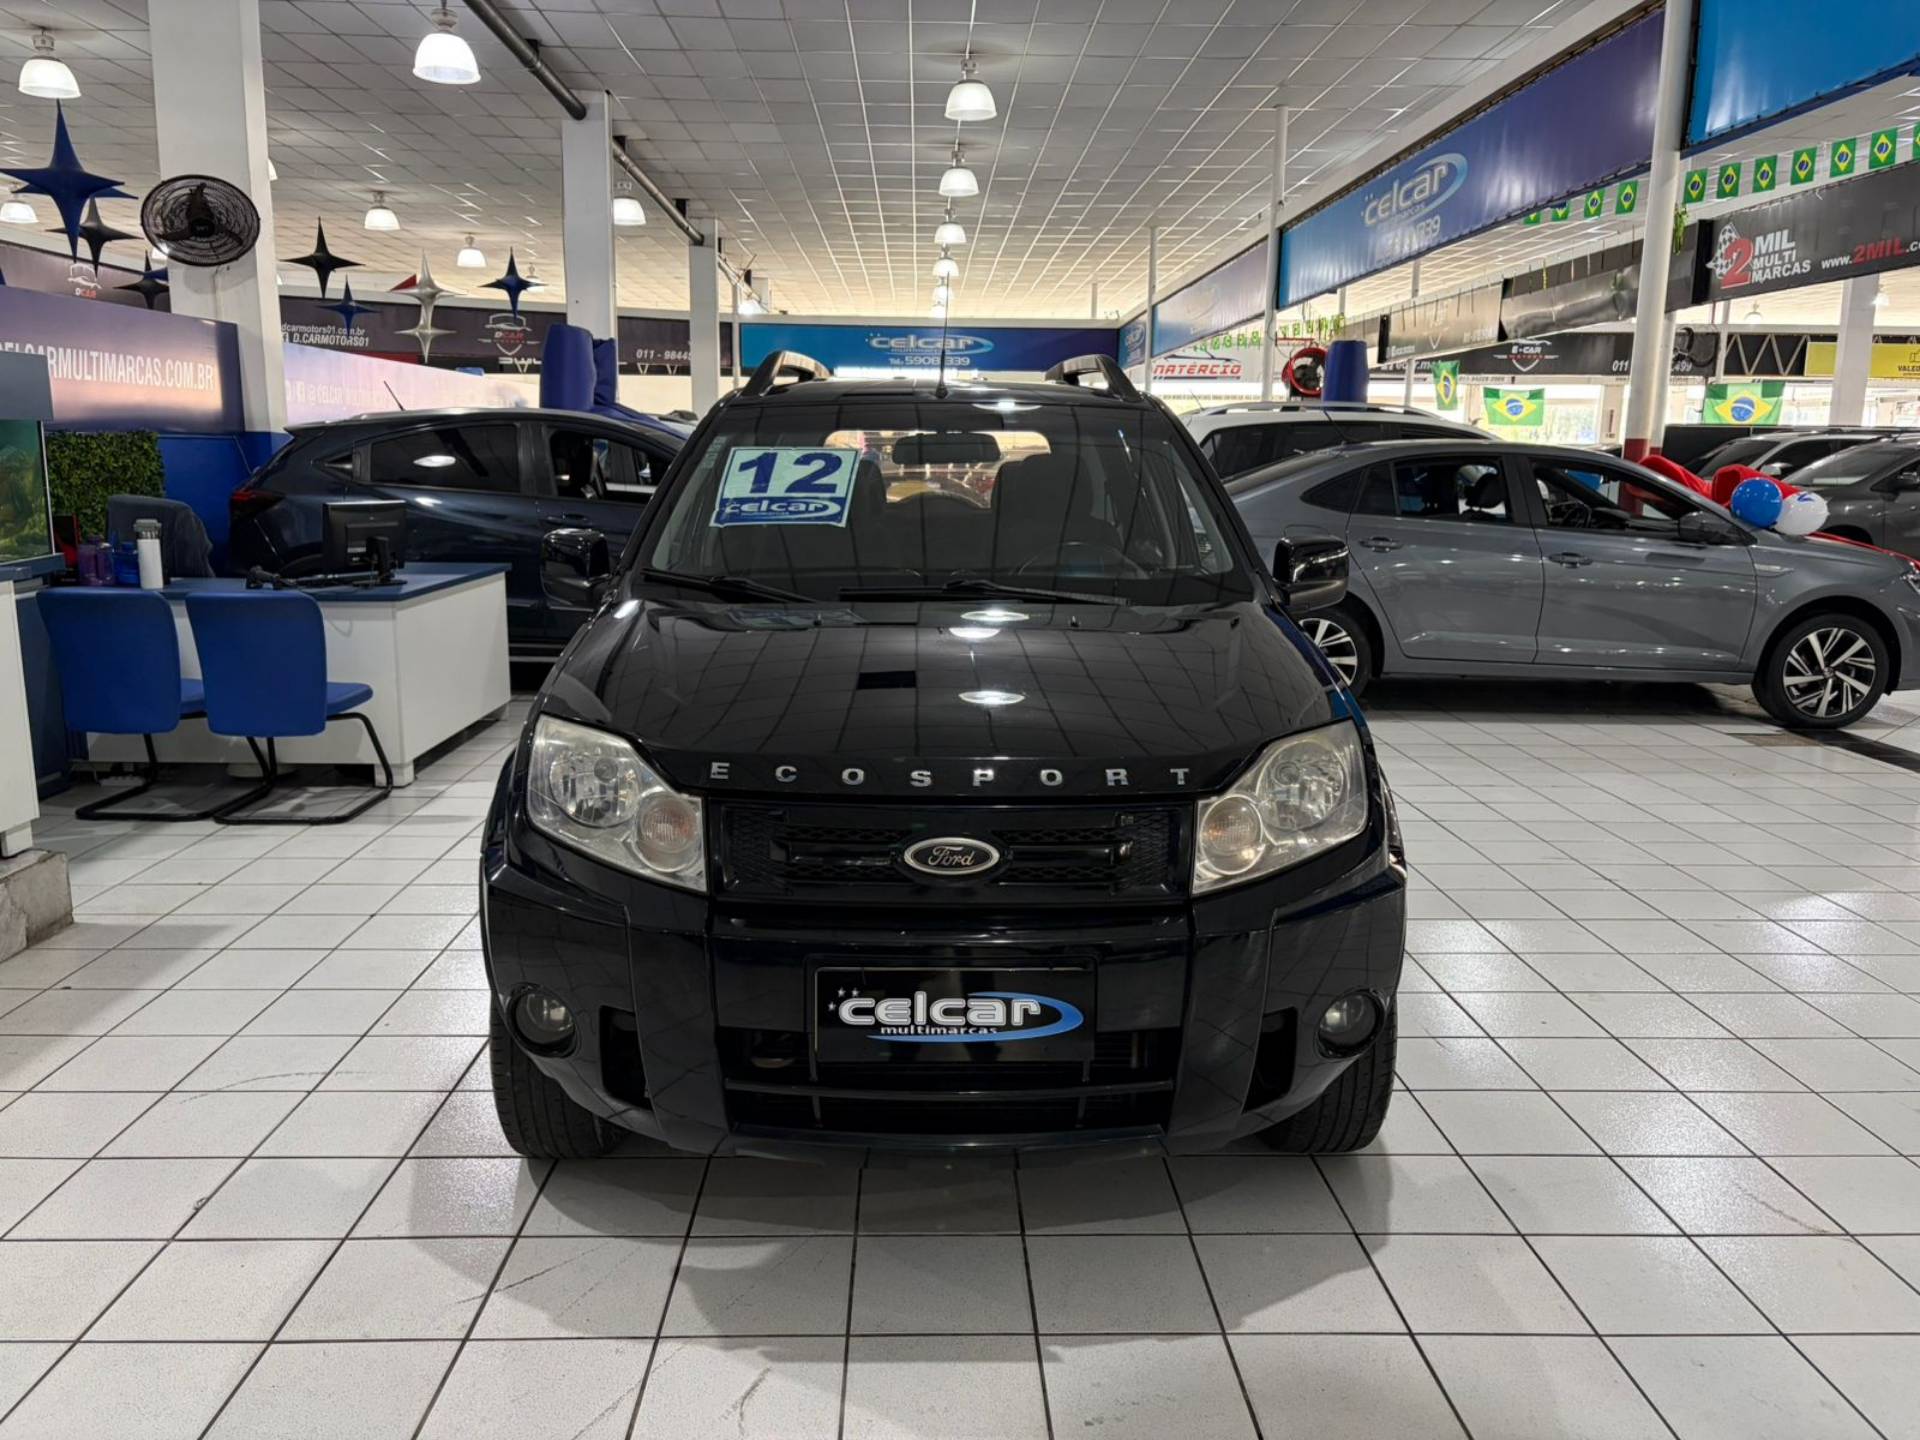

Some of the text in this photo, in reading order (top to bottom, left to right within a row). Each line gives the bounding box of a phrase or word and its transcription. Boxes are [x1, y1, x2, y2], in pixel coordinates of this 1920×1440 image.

[1721, 229, 1795, 289] 2 MIL
[1752, 250, 1797, 270] MULTI
[1821, 238, 1920, 269] www.2MIL.c
[1751, 260, 1811, 283] MARCAS
[869, 334, 975, 349] celcar
[636, 348, 655, 360] 011
[904, 356, 971, 366] 5908339
[738, 452, 843, 494] 12
[724, 500, 825, 513] celcar
[709, 761, 1190, 788] ECOSPORT
[928, 846, 976, 866] Ford
[839, 990, 1041, 1026] celcar
[880, 1024, 998, 1036] multimarcas
